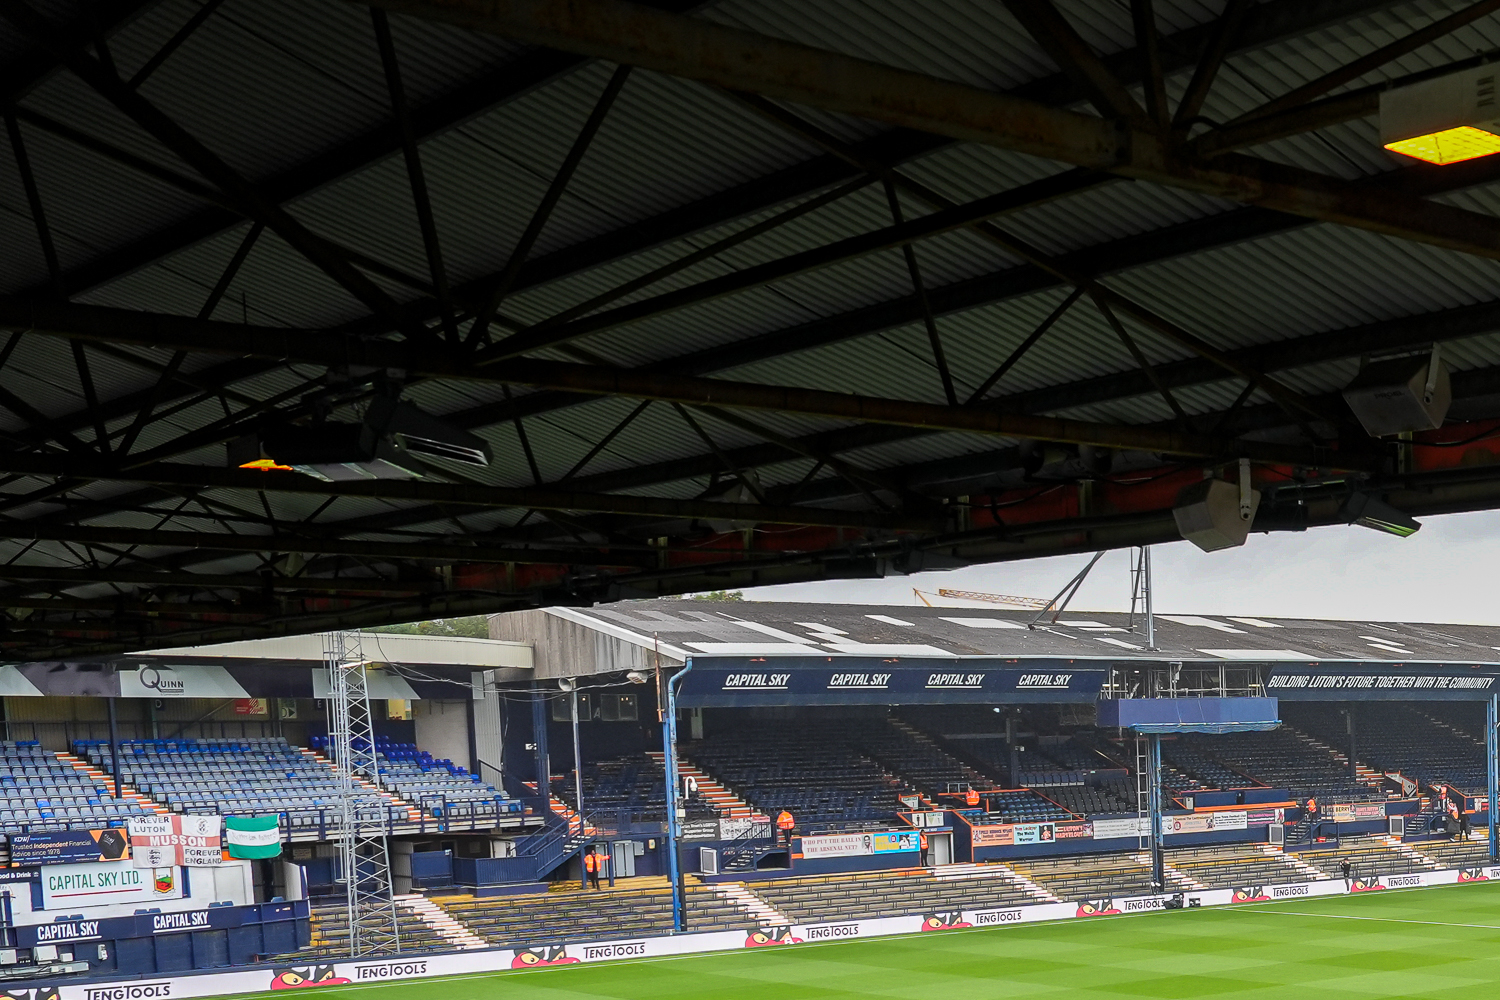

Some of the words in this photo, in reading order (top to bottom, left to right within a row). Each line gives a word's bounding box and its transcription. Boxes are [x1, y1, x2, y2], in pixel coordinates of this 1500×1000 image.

[140, 667, 184, 692] QUINN
[725, 674, 767, 686] CAPITAL
[768, 674, 791, 686] SKY
[830, 674, 869, 685] CAPITAL
[870, 674, 892, 685] SKY
[927, 674, 965, 685] CAPITAL
[965, 674, 985, 685] SKY
[1018, 674, 1052, 686] CAPITAL
[1053, 674, 1072, 686] SKY
[1268, 675, 1309, 687] BUILDING
[1308, 676, 1345, 688] LUTON'S
[1343, 676, 1375, 688] FUTURE
[1374, 676, 1414, 688] TOGETHER
[1414, 677, 1435, 688] WITH
[1434, 677, 1450, 688] THE
[1449, 677, 1495, 689] COMMUNITY
[34, 841, 68, 850] Independent
[150, 836, 206, 847] MUSSON
[184, 848, 221, 856] FOREVER
[49, 874, 95, 891] CAPITAL
[98, 872, 118, 887] SKY
[121, 870, 143, 885] LTD.
[153, 913, 191, 929] CAPITAL
[191, 912, 209, 926] SKY
[37, 923, 79, 940] CAPITAL
[80, 921, 100, 936] SKY
